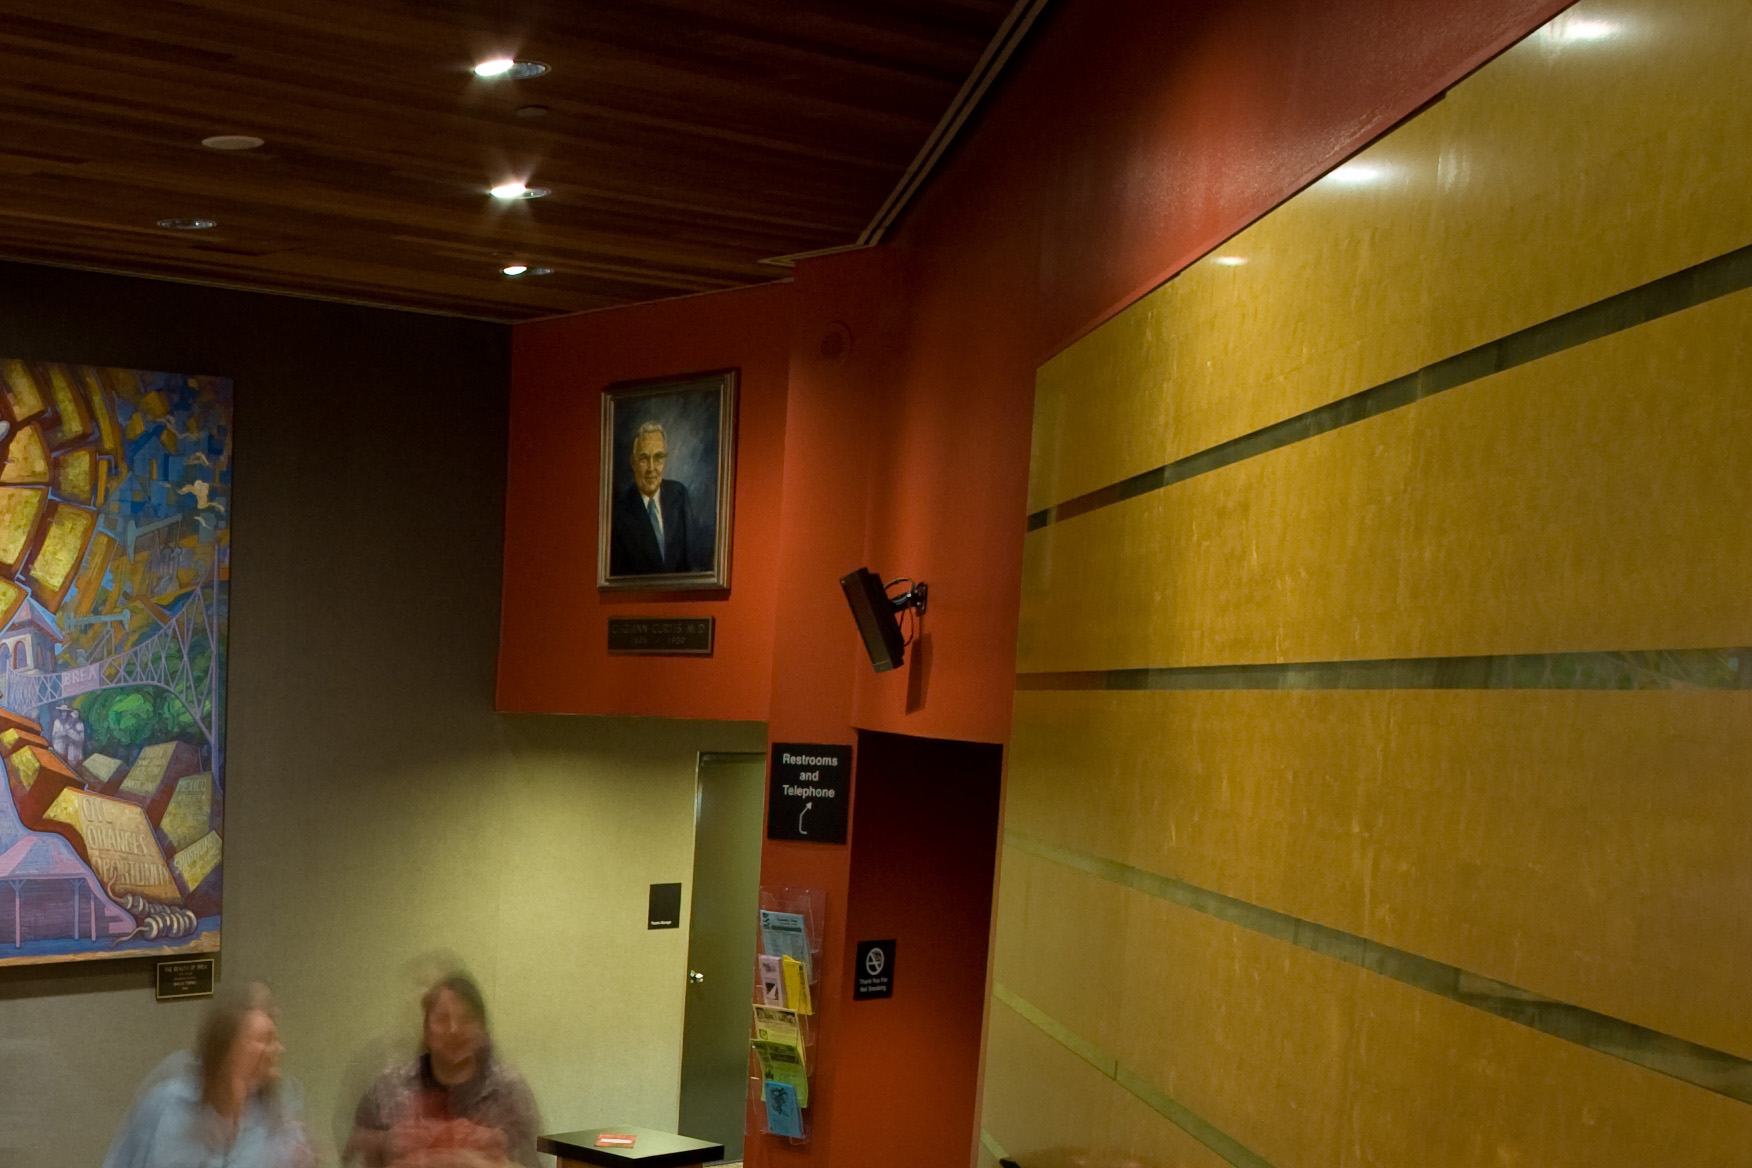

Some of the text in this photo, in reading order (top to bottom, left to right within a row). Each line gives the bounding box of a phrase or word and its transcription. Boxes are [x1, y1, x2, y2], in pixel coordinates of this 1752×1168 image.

[64, 666, 97, 686] BREA
[782, 753, 838, 767] Restrooms
[799, 770, 820, 782] and
[782, 784, 835, 799] Telephone
